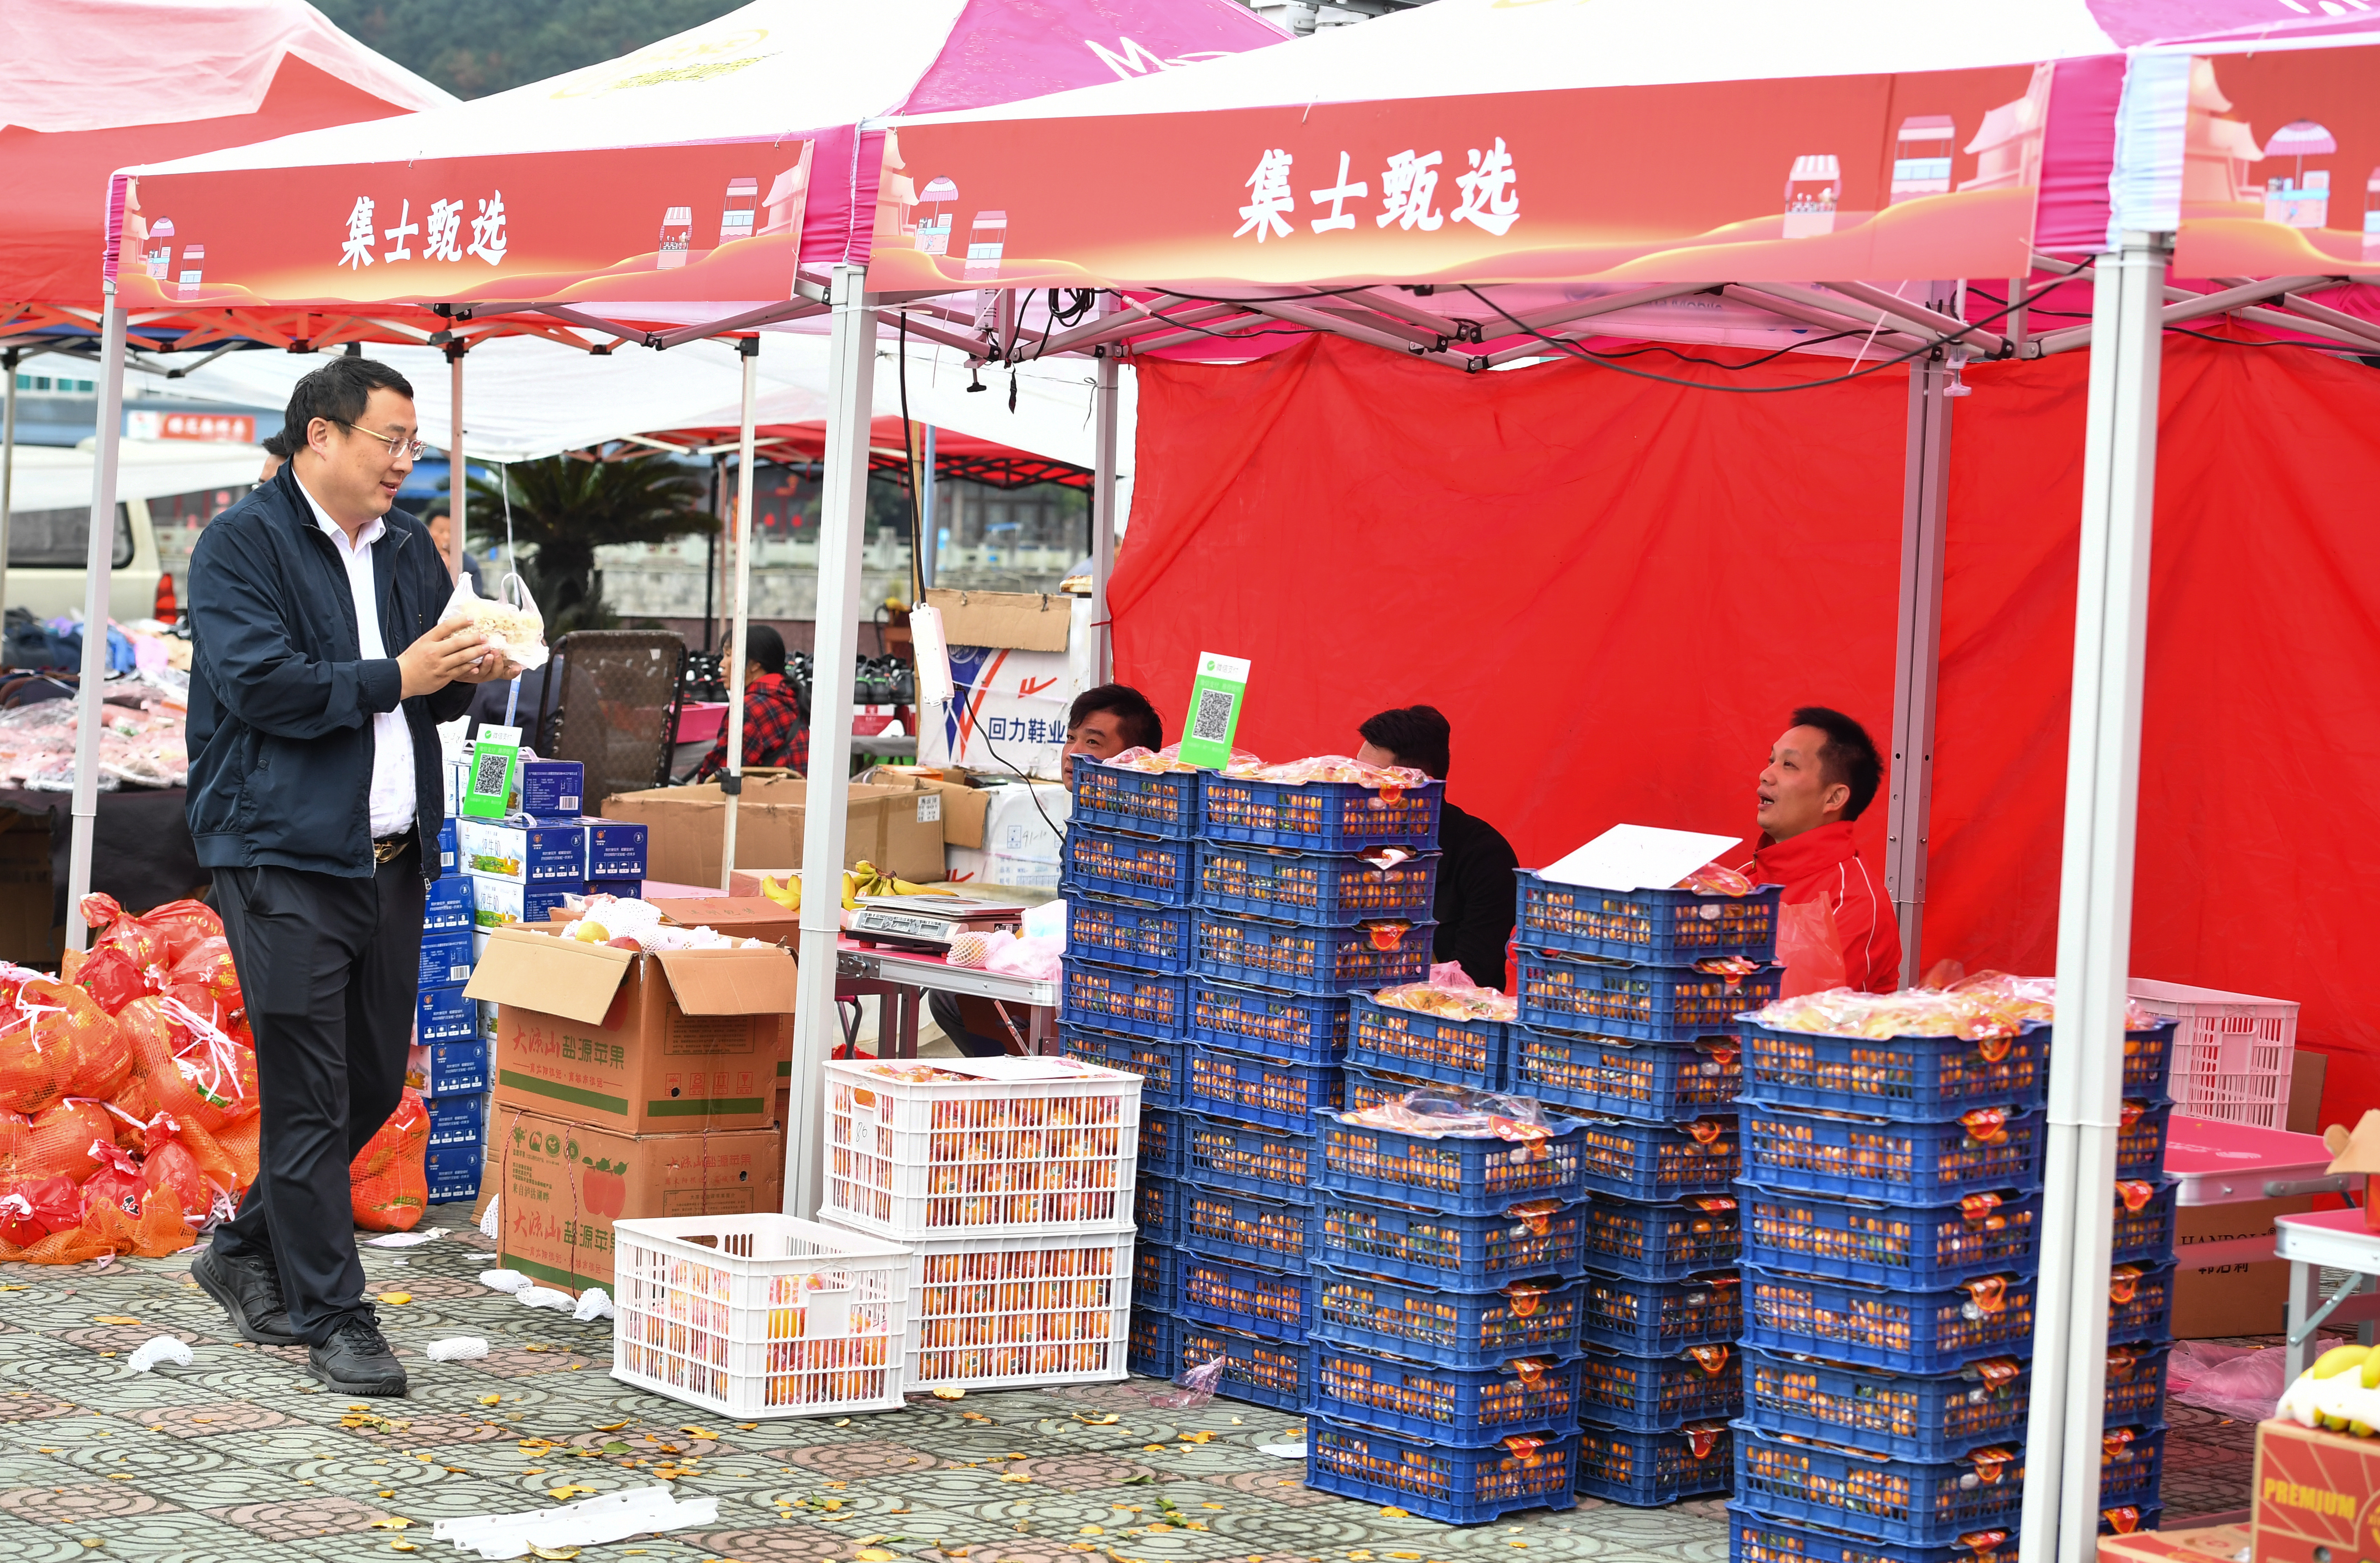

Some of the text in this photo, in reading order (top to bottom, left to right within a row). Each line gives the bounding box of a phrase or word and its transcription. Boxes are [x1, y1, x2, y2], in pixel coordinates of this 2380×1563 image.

[1233, 137, 1520, 243] 集士甄选
[338, 189, 508, 270] 集士甄选
[989, 717, 1065, 744] 回力鞋业
[513, 1023, 624, 1070] 大凉山盐源苹果
[2264, 1477, 2357, 1520] PREMIUM
